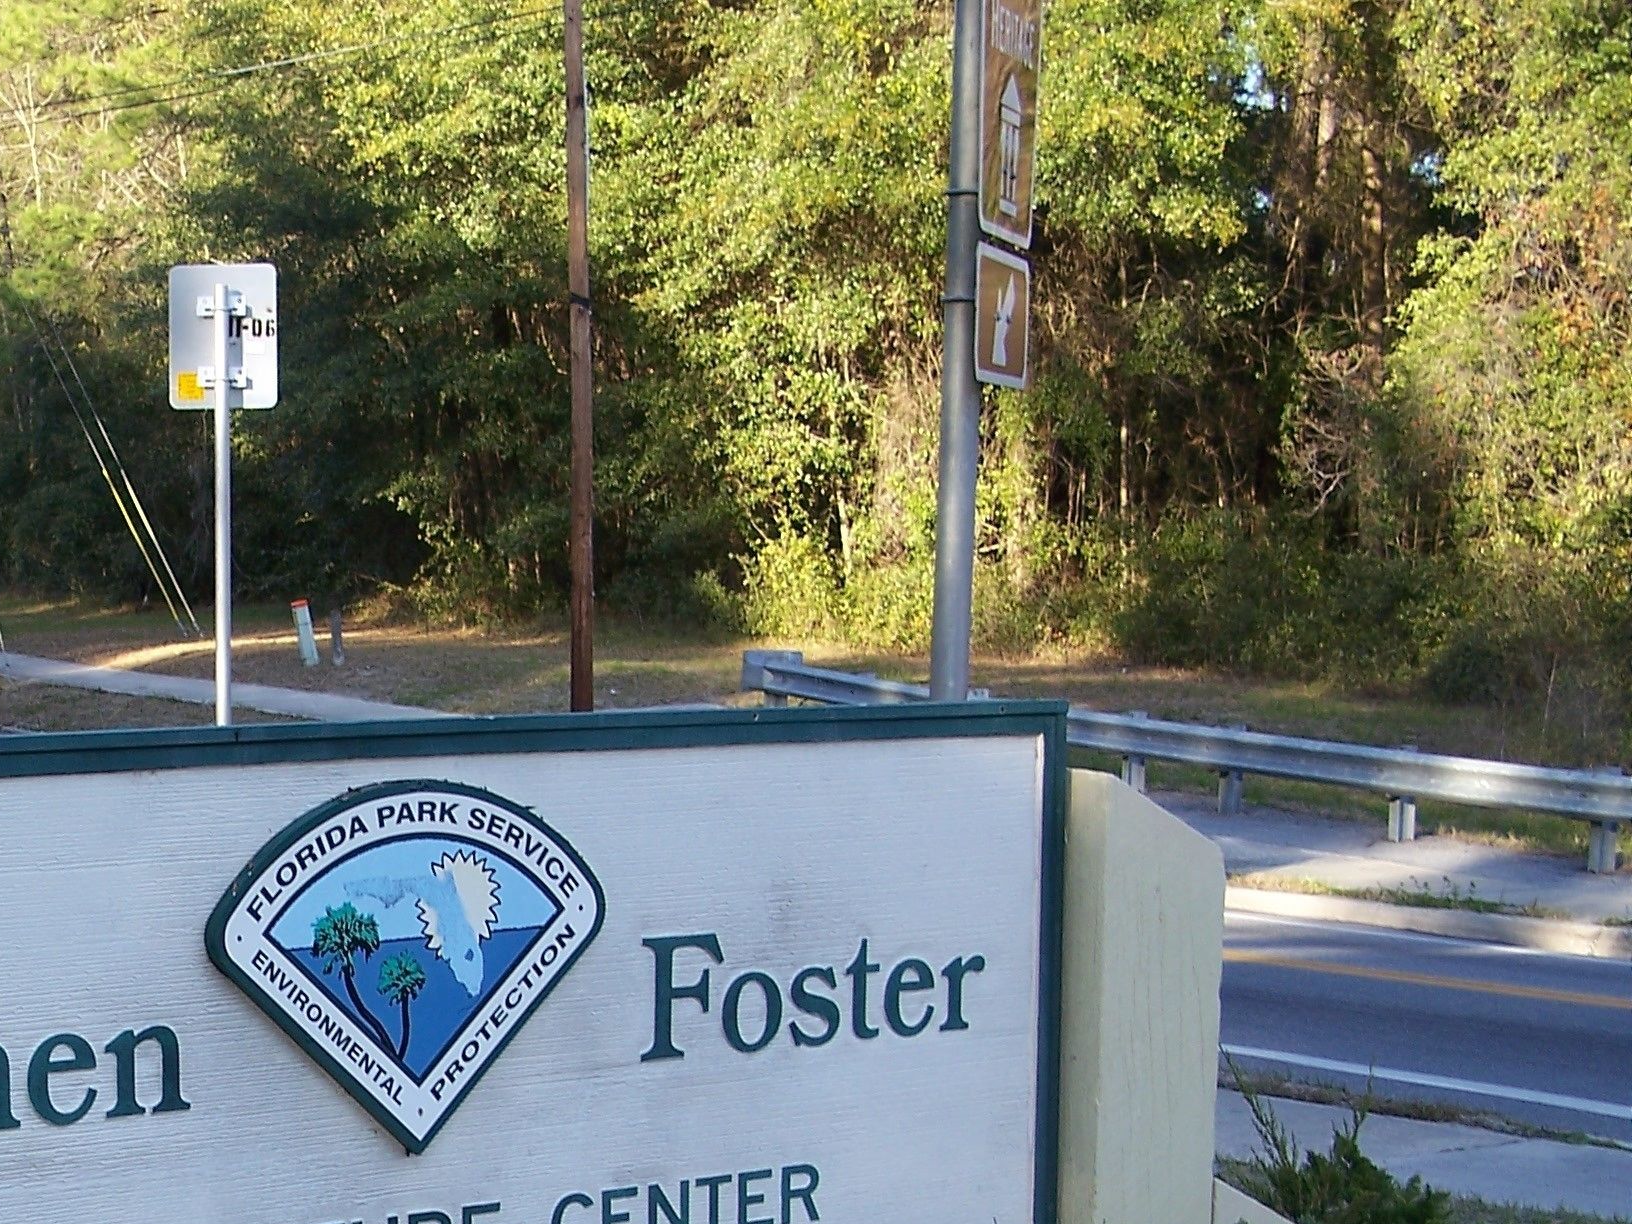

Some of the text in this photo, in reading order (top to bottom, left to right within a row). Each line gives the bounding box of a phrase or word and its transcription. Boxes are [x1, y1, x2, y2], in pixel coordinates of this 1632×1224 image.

[246, 800, 581, 922] FLORIDA PARK SERVICE
[251, 949, 403, 1106] ENVIRONMENTAL
[430, 922, 577, 1102] PROTECTION
[640, 932, 986, 1062] Foster
